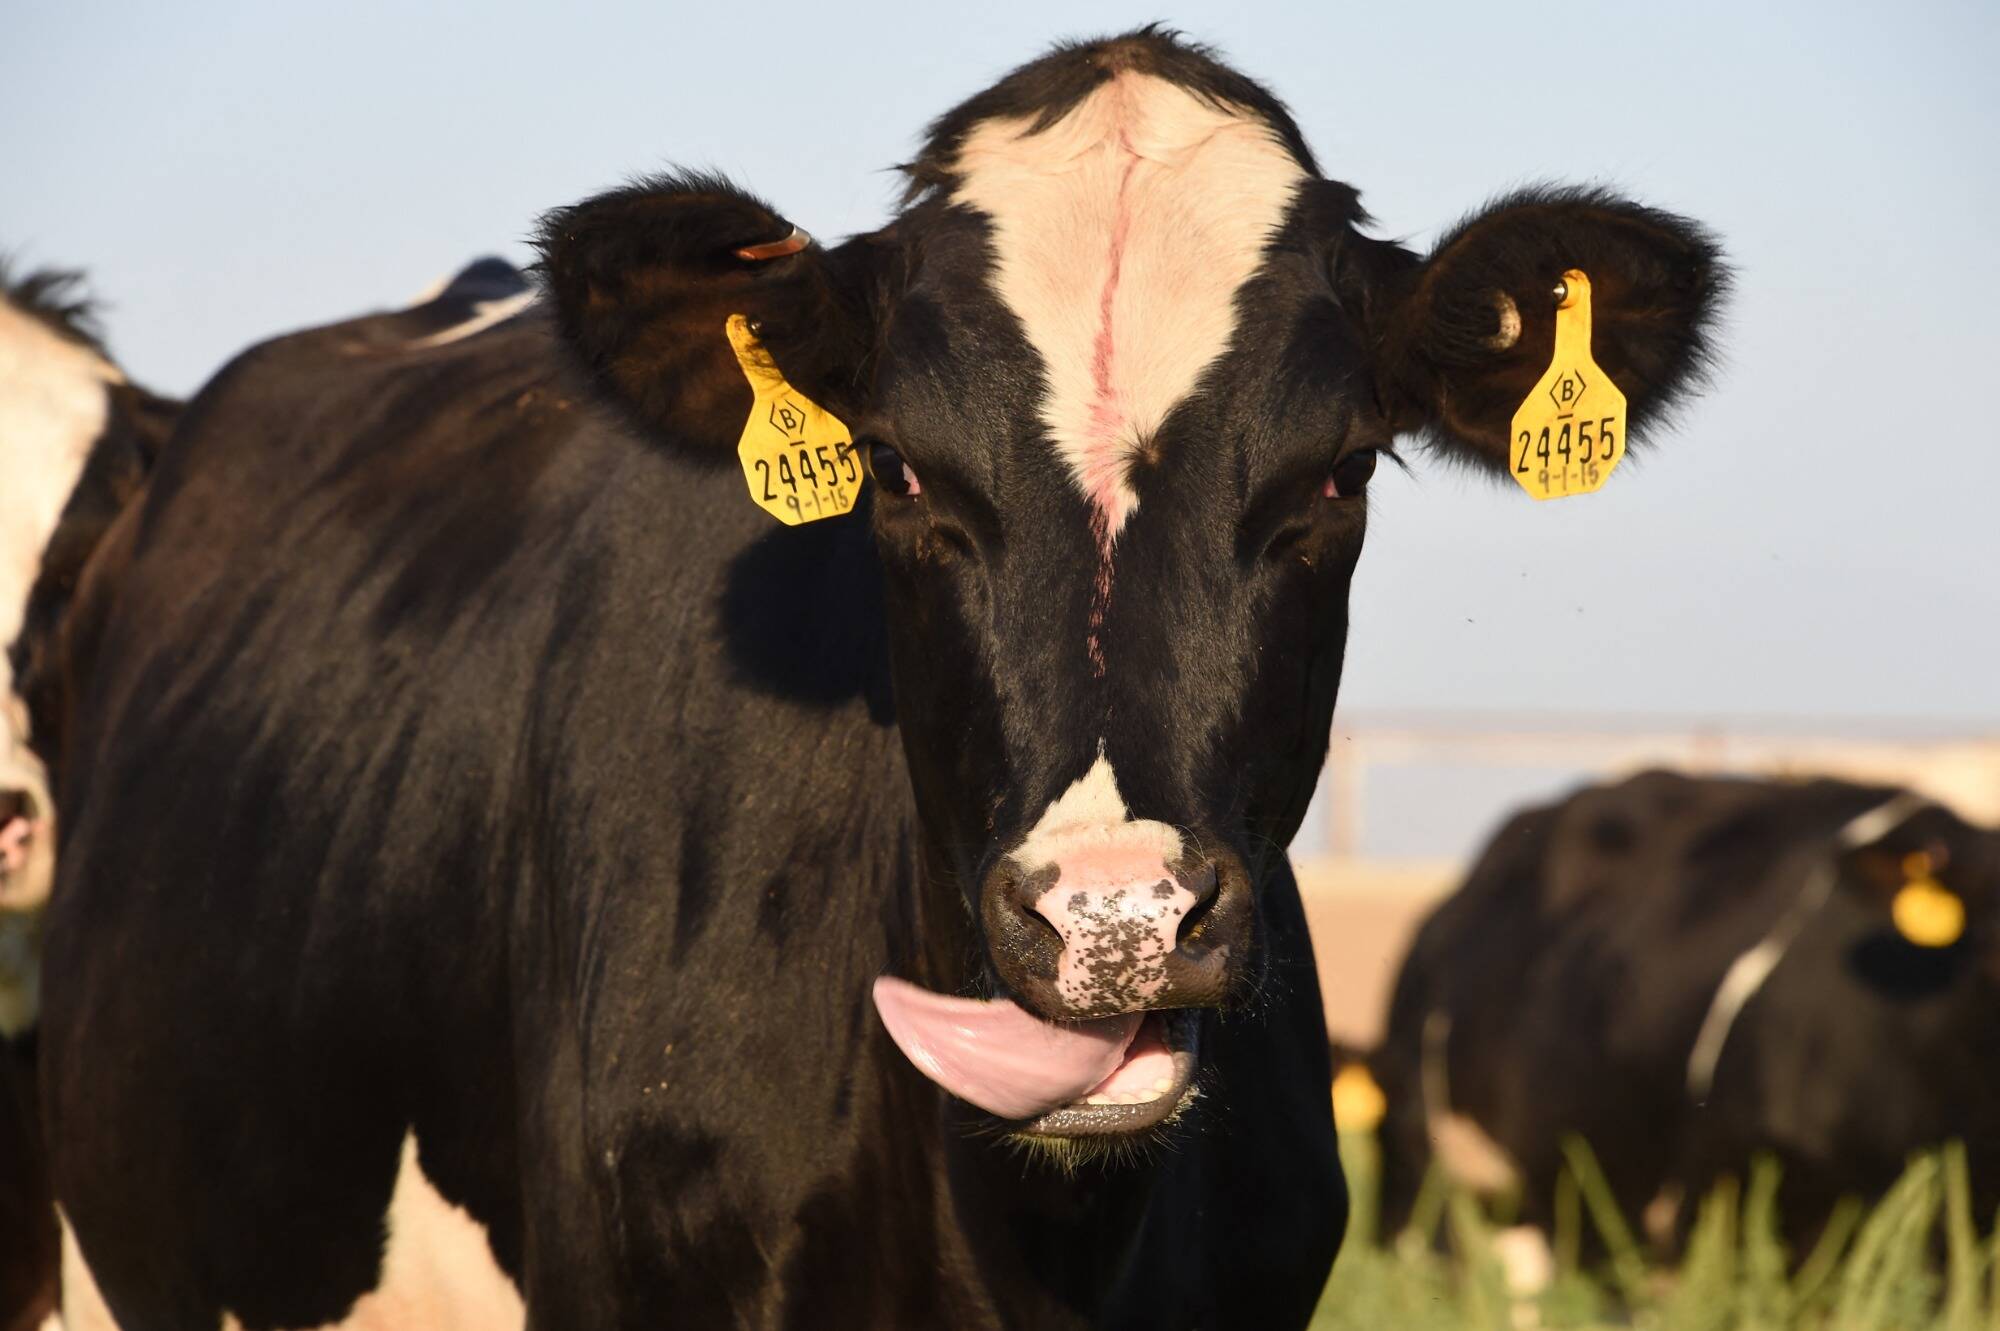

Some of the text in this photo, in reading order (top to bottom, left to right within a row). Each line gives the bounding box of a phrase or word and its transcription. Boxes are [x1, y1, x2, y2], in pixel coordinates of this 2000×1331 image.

[1517, 417, 1615, 474] 24455
[754, 442, 856, 502] 24455
[1538, 461, 1599, 494] 9-1-15
[786, 486, 849, 522] 9-1-15
